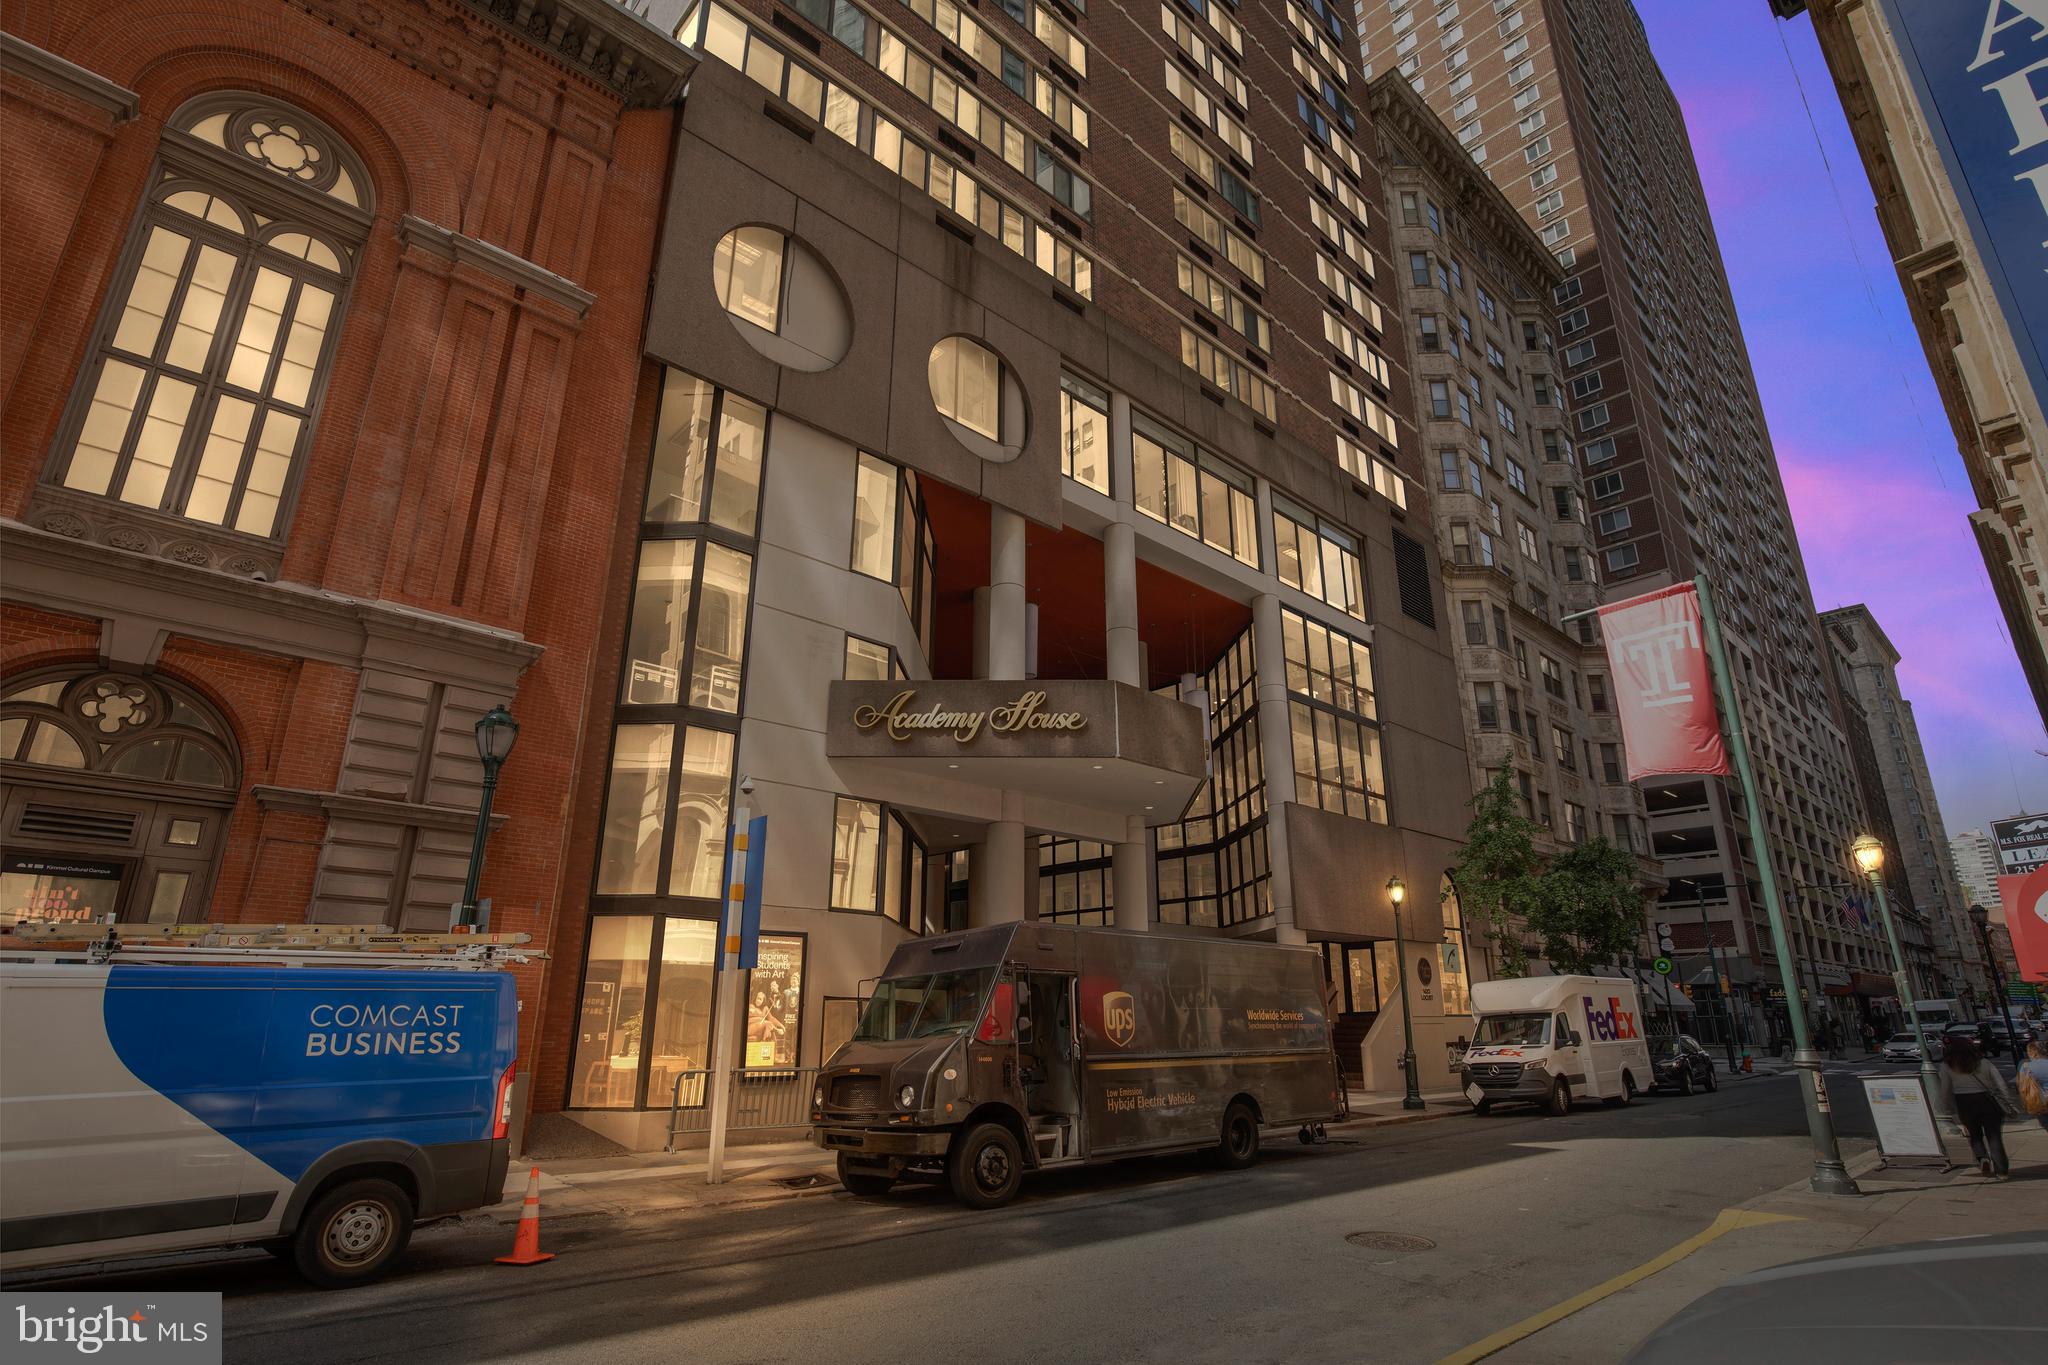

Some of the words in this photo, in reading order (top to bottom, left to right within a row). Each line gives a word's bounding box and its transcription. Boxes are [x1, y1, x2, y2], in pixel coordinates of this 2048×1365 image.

[853, 690, 985, 742] Academy
[989, 691, 1088, 732] House
[2013, 835, 2026, 843] FOX
[758, 952, 789, 962] nspiring
[757, 961, 790, 969] Students
[754, 970, 771, 978] with
[772, 970, 785, 979] Art
[310, 1004, 464, 1027] COMCAST
[1247, 1009, 1279, 1020] Worldwide
[1280, 1010, 1304, 1020] Services
[1583, 996, 1638, 1041] FedEx
[1106, 1008, 1133, 1038] ups
[306, 1032, 461, 1057] BUSINESS
[1470, 1048, 1523, 1058] FedEx
[1106, 1088, 1118, 1097] Low
[1119, 1087, 1143, 1096] Emission
[1107, 1097, 1135, 1114] Hybrid
[1137, 1095, 1166, 1109] Electric
[1167, 1091, 1196, 1105] Vehicle
